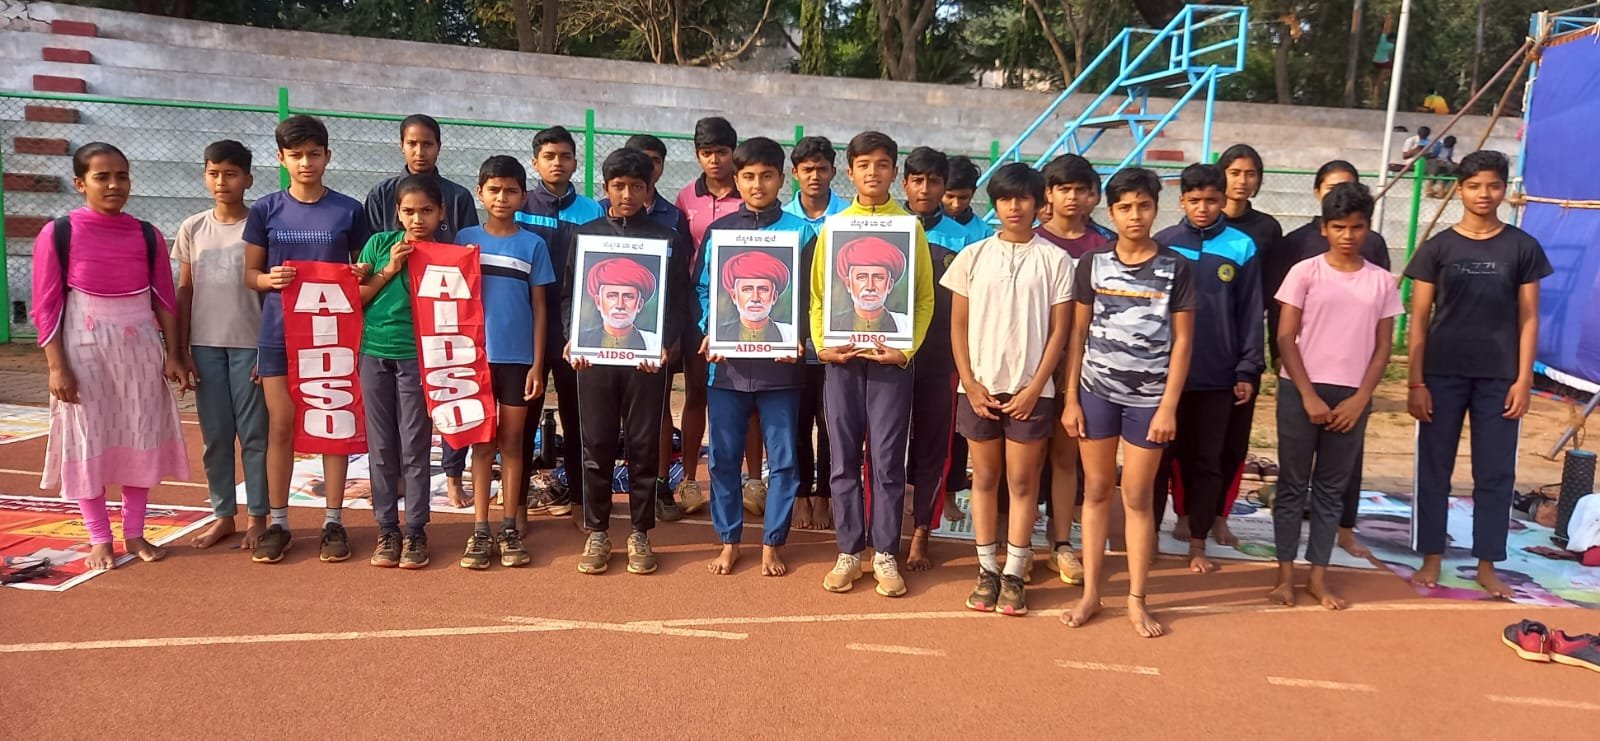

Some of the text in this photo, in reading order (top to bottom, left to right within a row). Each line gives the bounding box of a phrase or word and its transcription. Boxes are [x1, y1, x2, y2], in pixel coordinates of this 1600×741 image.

[849, 333, 887, 345] AIDSO
[417, 264, 485, 435] AIDSO
[735, 342, 773, 353] AIDSO
[293, 281, 356, 440] AIDSO
[597, 350, 635, 360] AIDSO
